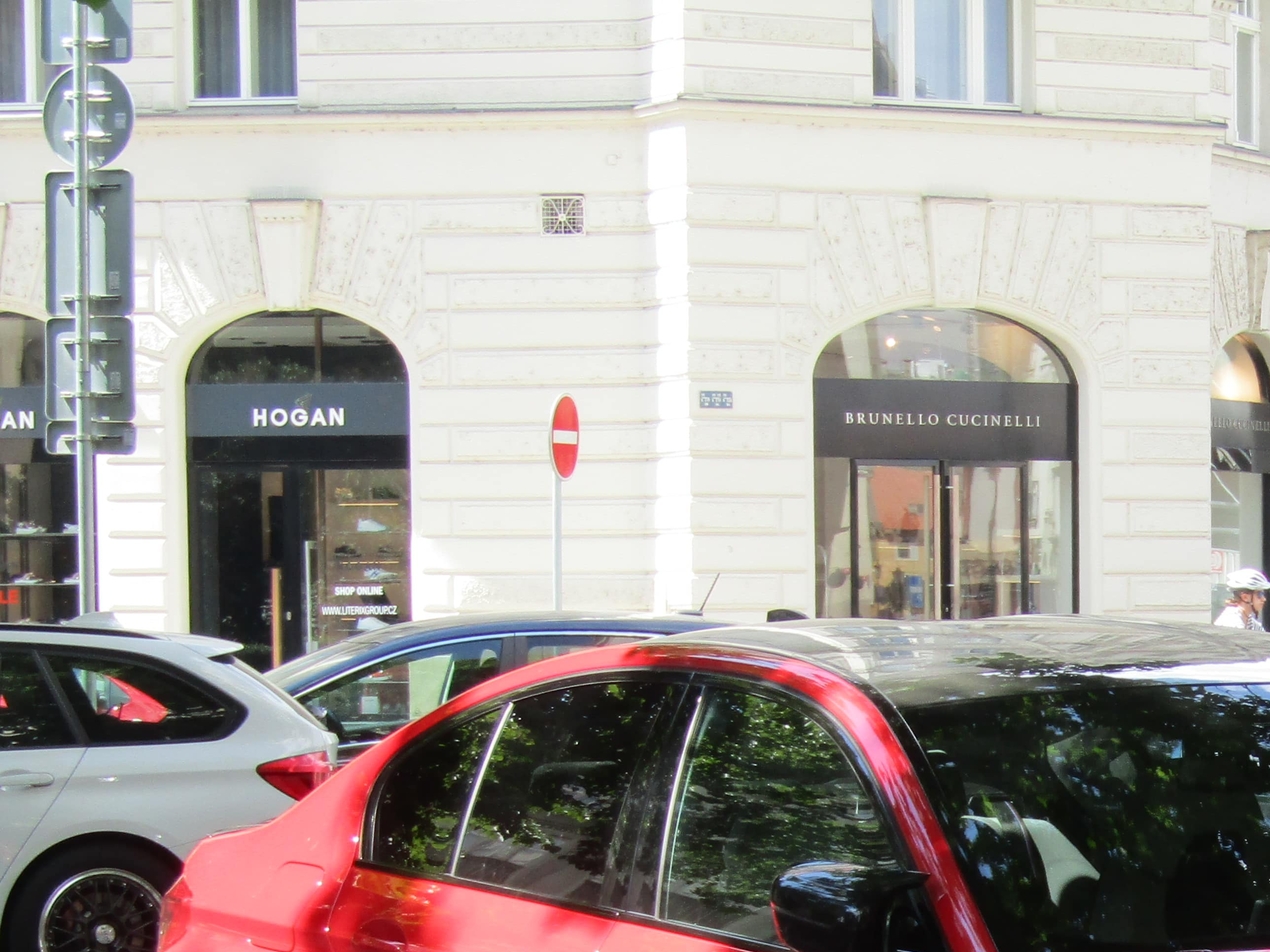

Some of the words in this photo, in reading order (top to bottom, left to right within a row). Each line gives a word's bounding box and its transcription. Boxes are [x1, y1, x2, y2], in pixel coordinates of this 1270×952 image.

[252, 407, 345, 427] HOGAN
[845, 412, 940, 426] BRUNELLO
[947, 414, 1041, 428] CUCINELLI
[334, 586, 355, 596] SHOP
[356, 586, 384, 596] ONLINE
